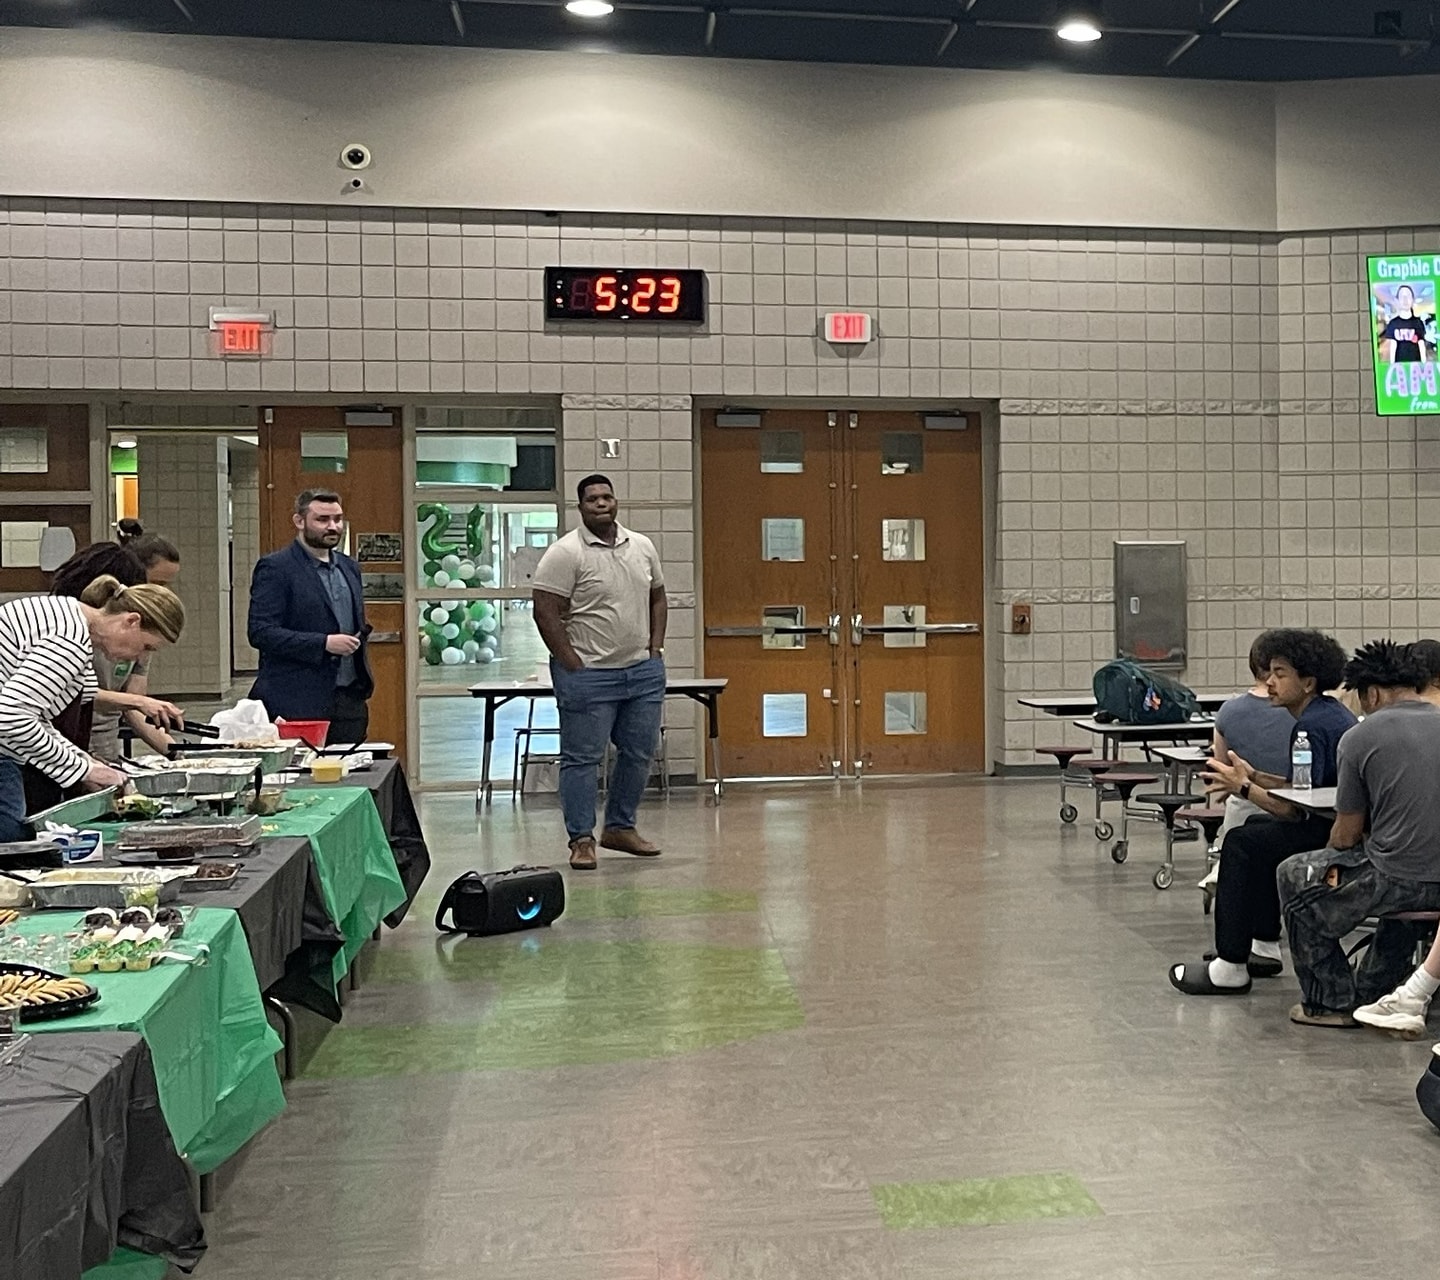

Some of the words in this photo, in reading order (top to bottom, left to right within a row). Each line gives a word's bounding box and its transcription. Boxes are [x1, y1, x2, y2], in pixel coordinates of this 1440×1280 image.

[1377, 258, 1430, 280] Graphic
[595, 276, 681, 313] 5:23
[224, 323, 260, 350] EXIT
[833, 315, 865, 339] EXIT
[1409, 397, 1438, 413] from
